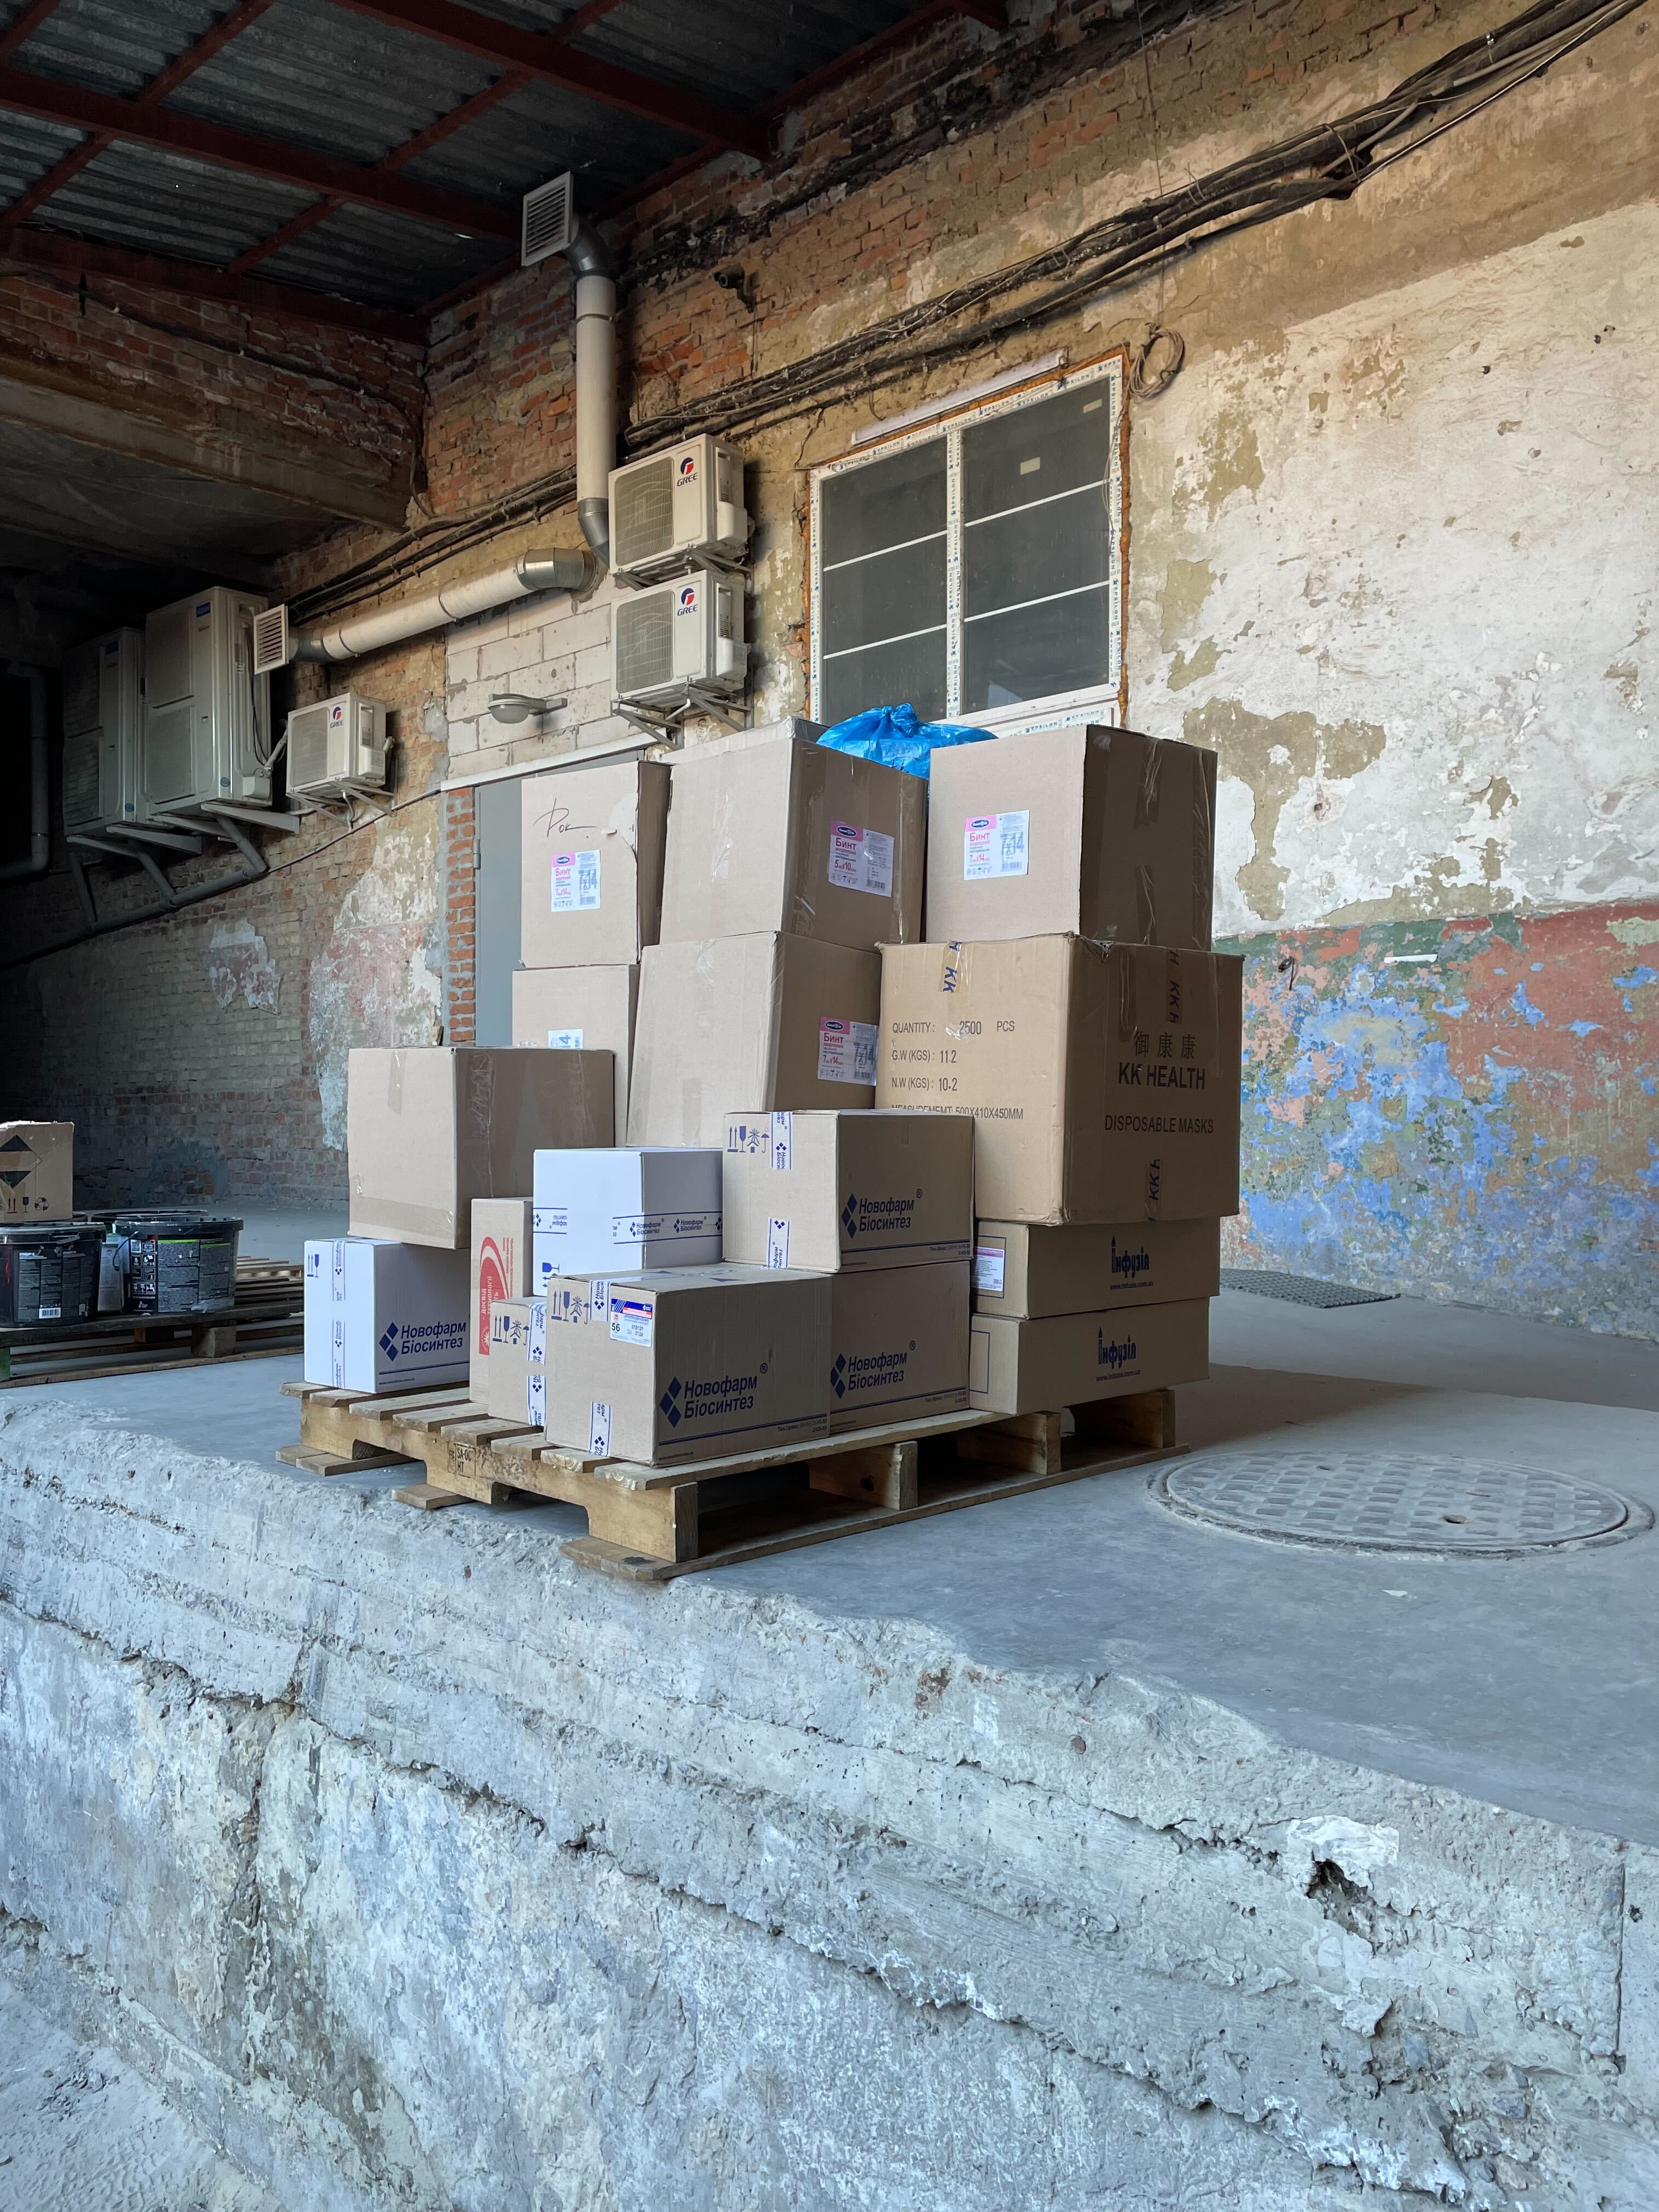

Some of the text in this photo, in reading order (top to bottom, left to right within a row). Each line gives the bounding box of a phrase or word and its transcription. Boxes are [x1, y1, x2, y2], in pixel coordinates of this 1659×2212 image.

[677, 472, 698, 487] GREE
[677, 605, 698, 617] GREE
[330, 719, 345, 729] GREE
[1031, 721, 1058, 731] EPSILON
[836, 837, 857, 850] Бинт
[969, 832, 990, 842] Бинт
[959, 1020, 982, 1035] 2500
[997, 1020, 1015, 1032] PCS
[824, 1032, 844, 1043] Бинт
[1118, 1062, 1205, 1090] KK HEALTH
[939, 1077, 957, 1091] 10.2
[1104, 1115, 1214, 1133] DISPOSABLE MASKS
[859, 1197, 915, 1216] Новофарм
[859, 1216, 911, 1232] Біосинтез
[400, 1322, 466, 1339] Новофарм
[611, 1322, 620, 1332] 56
[401, 1338, 464, 1355] Біосинтез
[848, 1352, 908, 1373] Новофарм
[684, 1375, 758, 1400] Новофарм
[848, 1370, 905, 1391] Біосинтез
[684, 1395, 754, 1419] Біосинтез
[457, 1460, 465, 1473] HT
